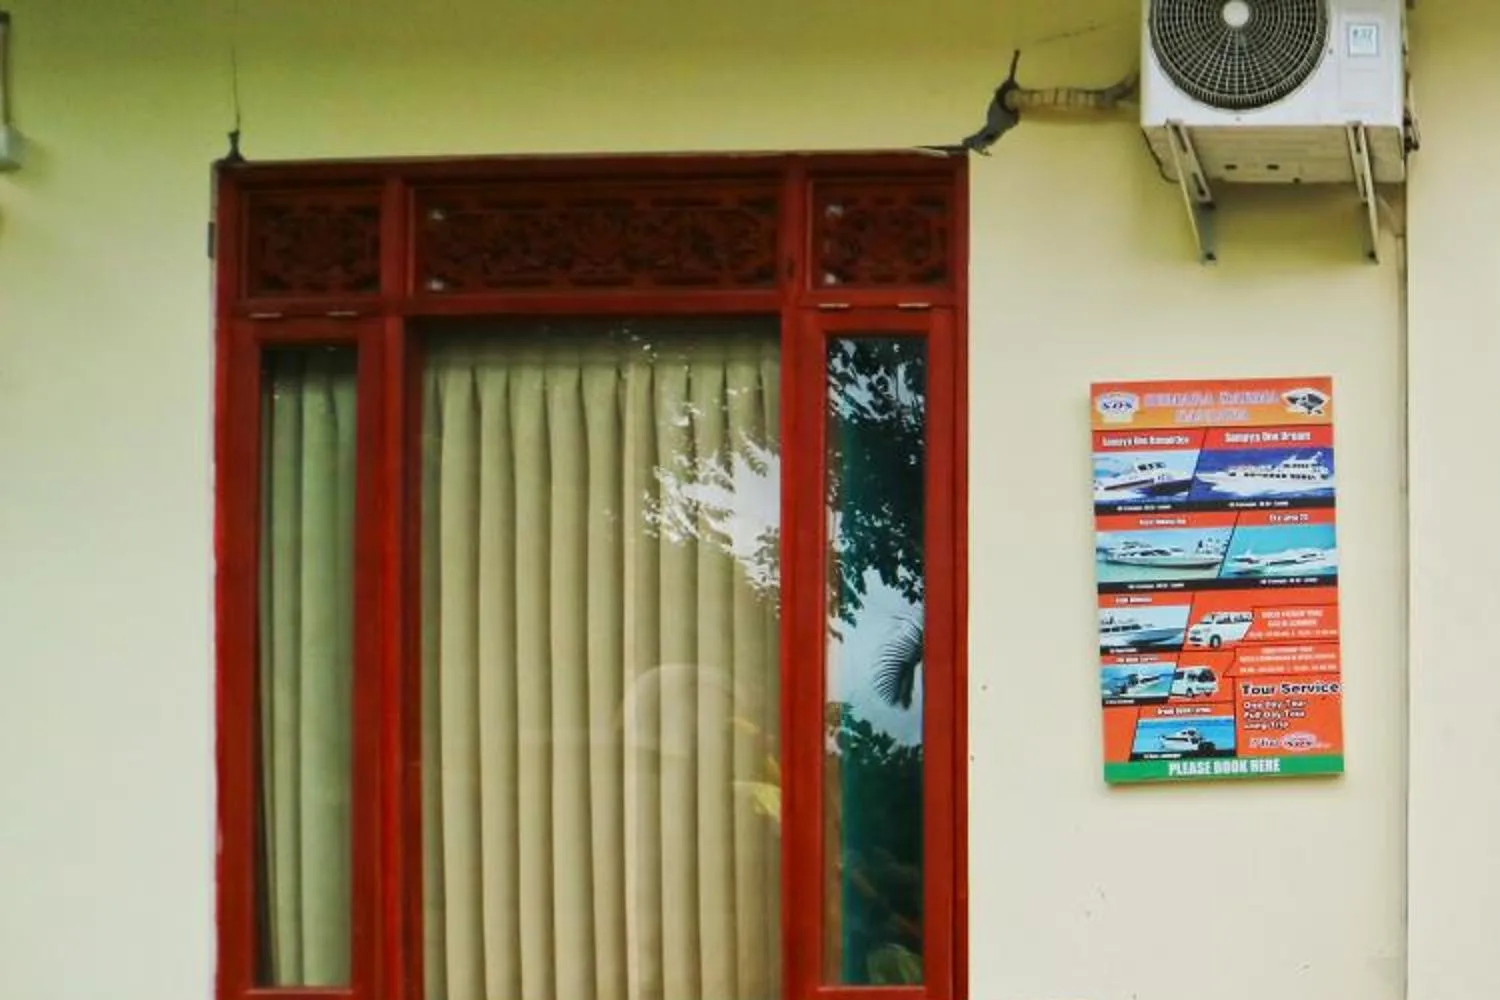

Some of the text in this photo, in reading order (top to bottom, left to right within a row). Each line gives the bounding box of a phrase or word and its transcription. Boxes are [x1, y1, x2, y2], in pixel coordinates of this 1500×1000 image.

[1242, 682, 1341, 696] Tour Service
[1169, 760, 1211, 776] PLEASE
[1250, 758, 1281, 773] HERE
